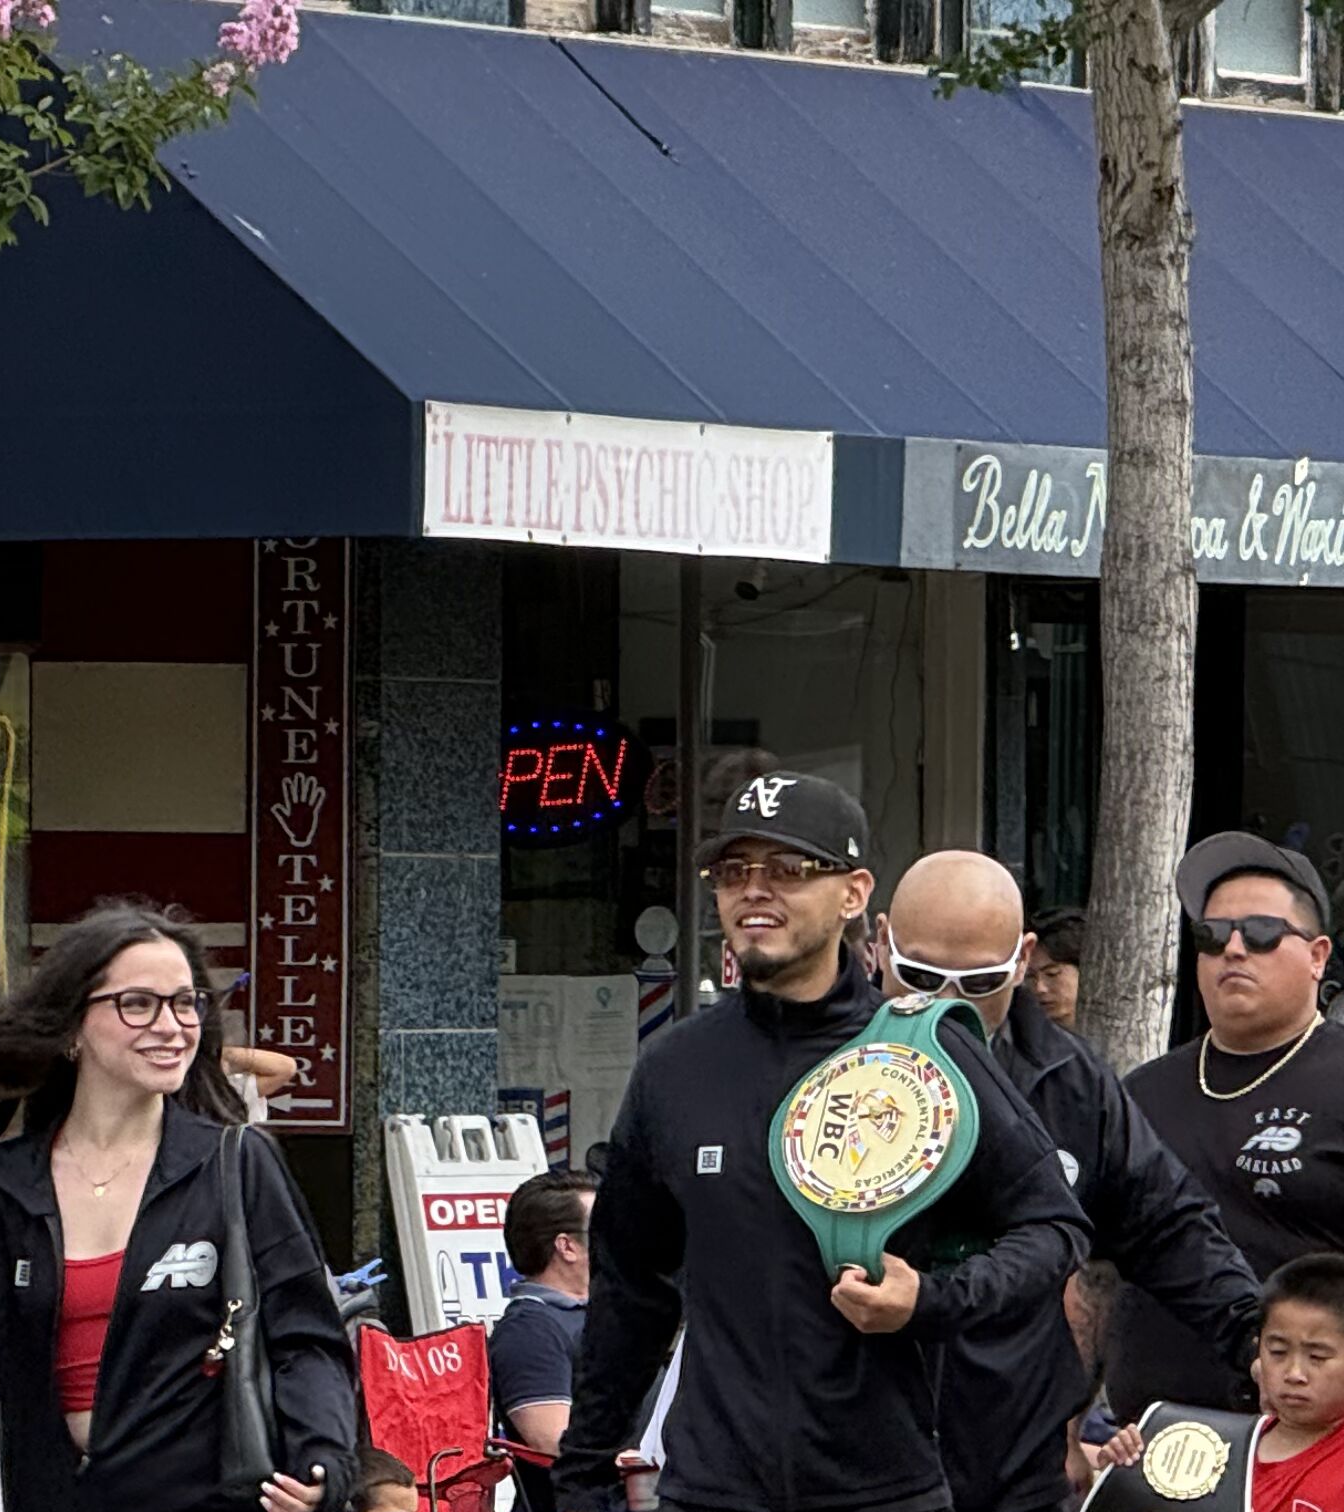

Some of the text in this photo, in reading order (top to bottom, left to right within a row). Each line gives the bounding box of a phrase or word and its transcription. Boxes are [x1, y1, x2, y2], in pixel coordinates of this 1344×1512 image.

[442, 431, 563, 531] LITTLE
[573, 441, 718, 545] PSYCHIC
[962, 454, 1068, 553] Bella
[1239, 473, 1269, 561] &
[500, 738, 628, 811] PEN
[818, 1092, 853, 1160] WBC
[854, 1067, 929, 1189] CONTINENTAL AMERICAS
[1254, 1107, 1312, 1125] EAST
[1236, 1154, 1303, 1175] OAKLAND
